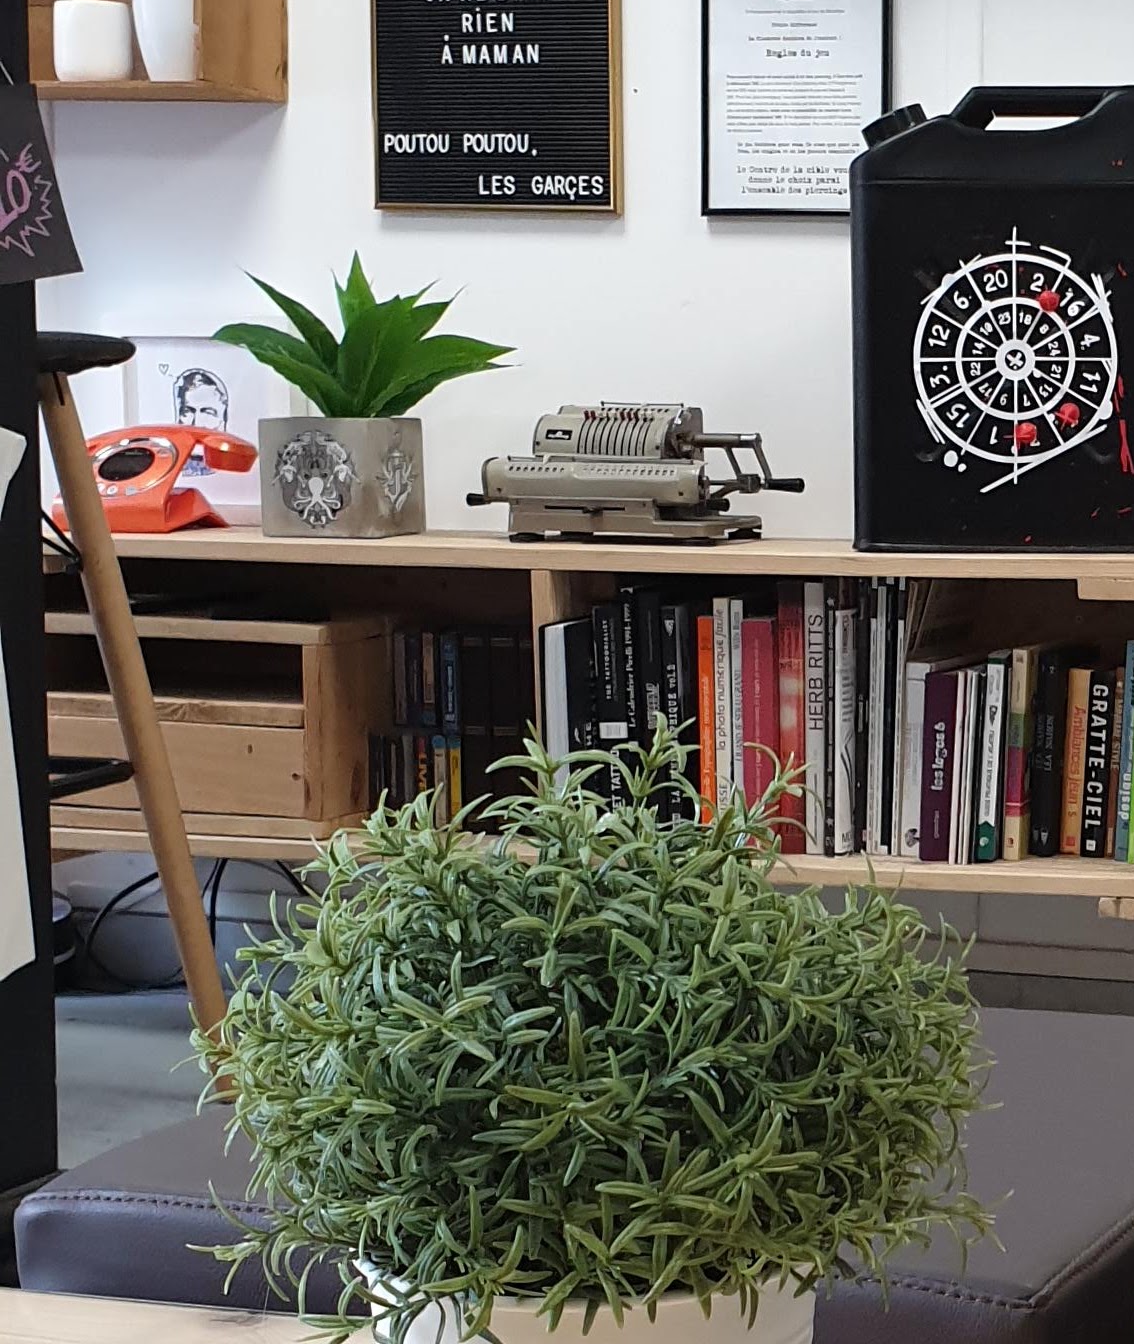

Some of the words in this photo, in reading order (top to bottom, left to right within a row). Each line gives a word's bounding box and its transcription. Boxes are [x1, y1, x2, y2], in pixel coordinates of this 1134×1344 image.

[462, 43, 540, 66] MAMAN
[800, 48, 811, 57] du
[815, 49, 830, 58] jeu
[384, 133, 450, 155] POUTOU
[463, 133, 538, 157] POUTOU,
[478, 175, 516, 196] LES
[531, 175, 604, 201] GARÇES
[983, 269, 1008, 293] 20
[1059, 287, 1085, 317] 16
[1018, 309, 1032, 324] 18
[1039, 323, 1050, 334] 8
[928, 324, 950, 348] 12
[990, 426, 999, 445] 1
[712, 609, 726, 638] facile
[808, 614, 823, 669] RITTS
[626, 674, 636, 716] Calendrier
[809, 678, 824, 730] HERB
[628, 718, 637, 728] Le
[714, 704, 729, 737] photo
[716, 740, 727, 751] la
[931, 732, 948, 769] logos
[1069, 705, 1087, 775] Ambiances
[1085, 684, 1109, 829] GRATTE-CIEL
[931, 771, 944, 791] les
